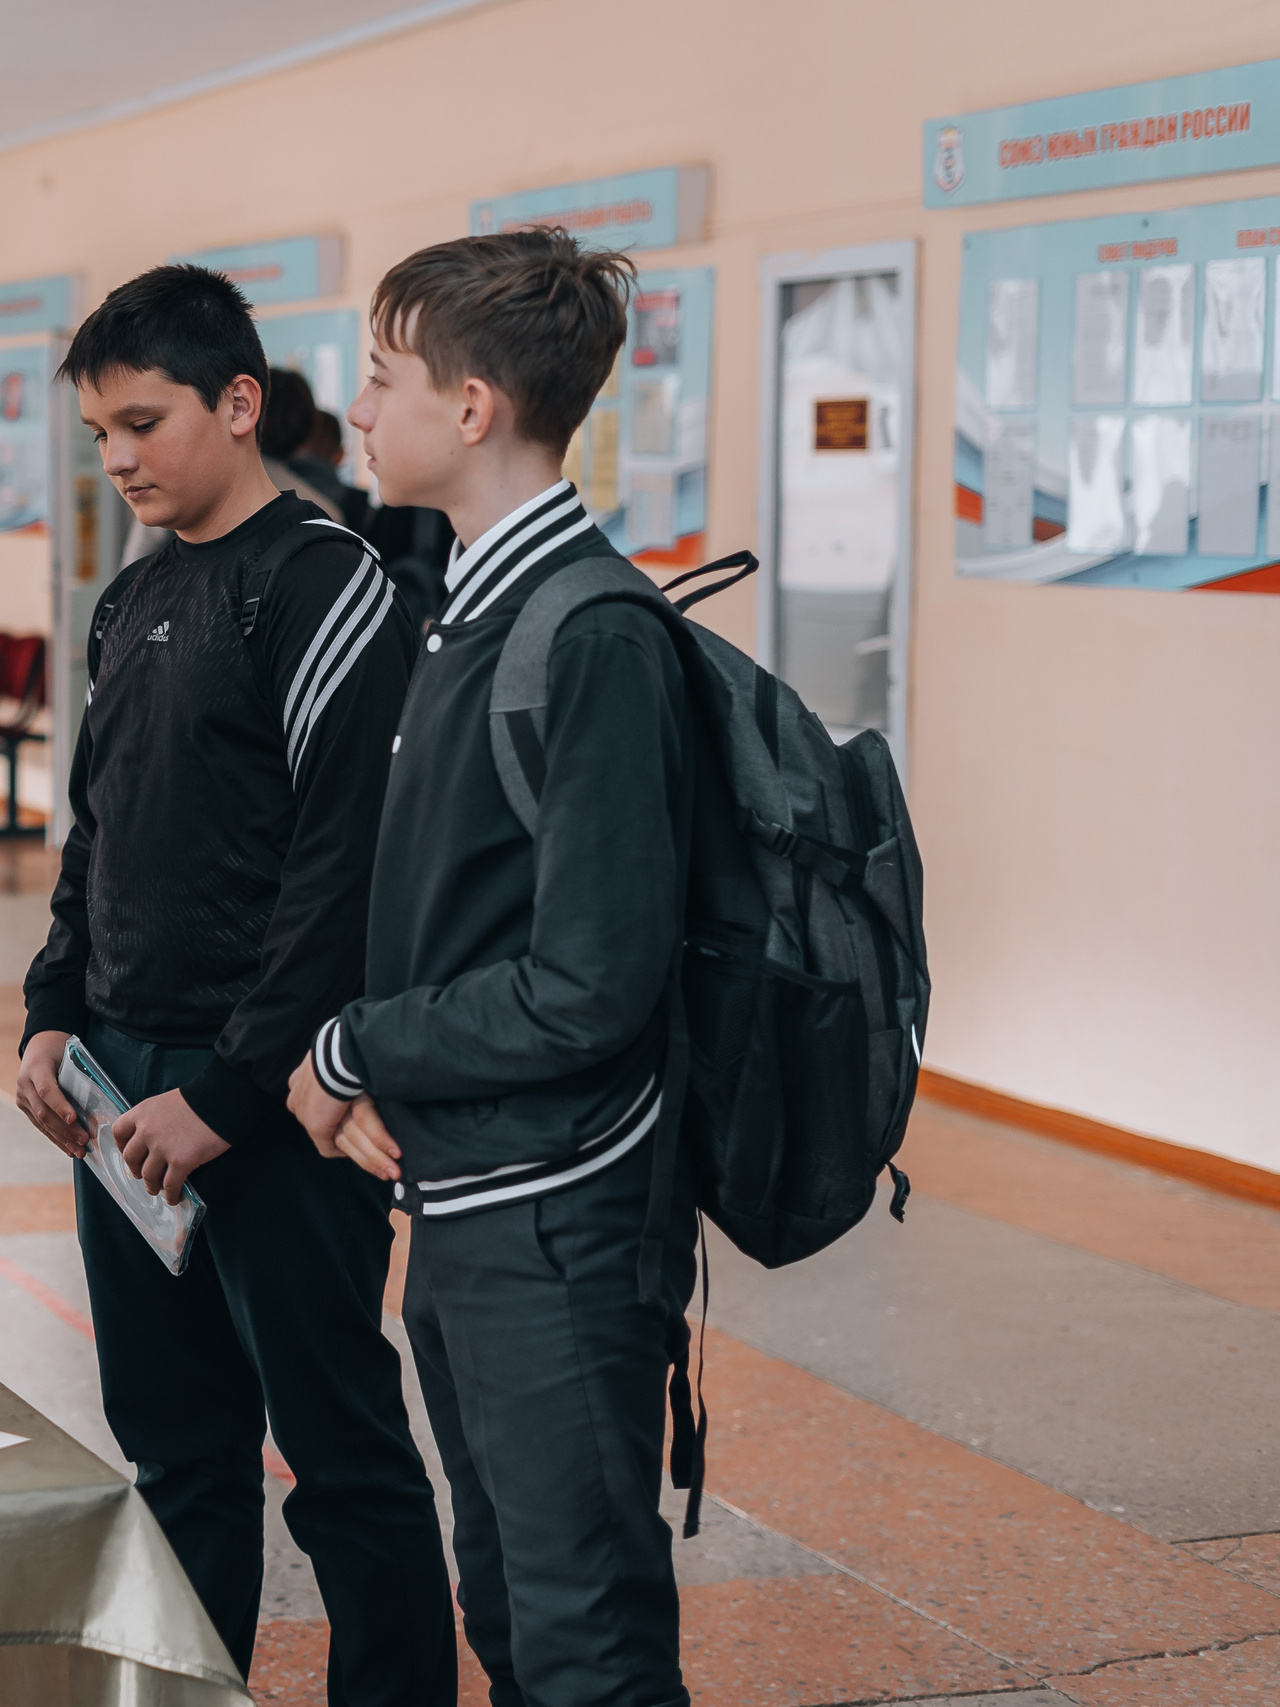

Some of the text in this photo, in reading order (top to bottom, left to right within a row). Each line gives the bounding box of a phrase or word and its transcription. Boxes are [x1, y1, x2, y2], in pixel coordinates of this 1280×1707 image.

[999, 135, 1043, 168] СОЮЗ
[1101, 113, 1178, 151] ГРАЖДАН
[1181, 102, 1251, 139] РОССИИ
[147, 633, 169, 641] adidas
